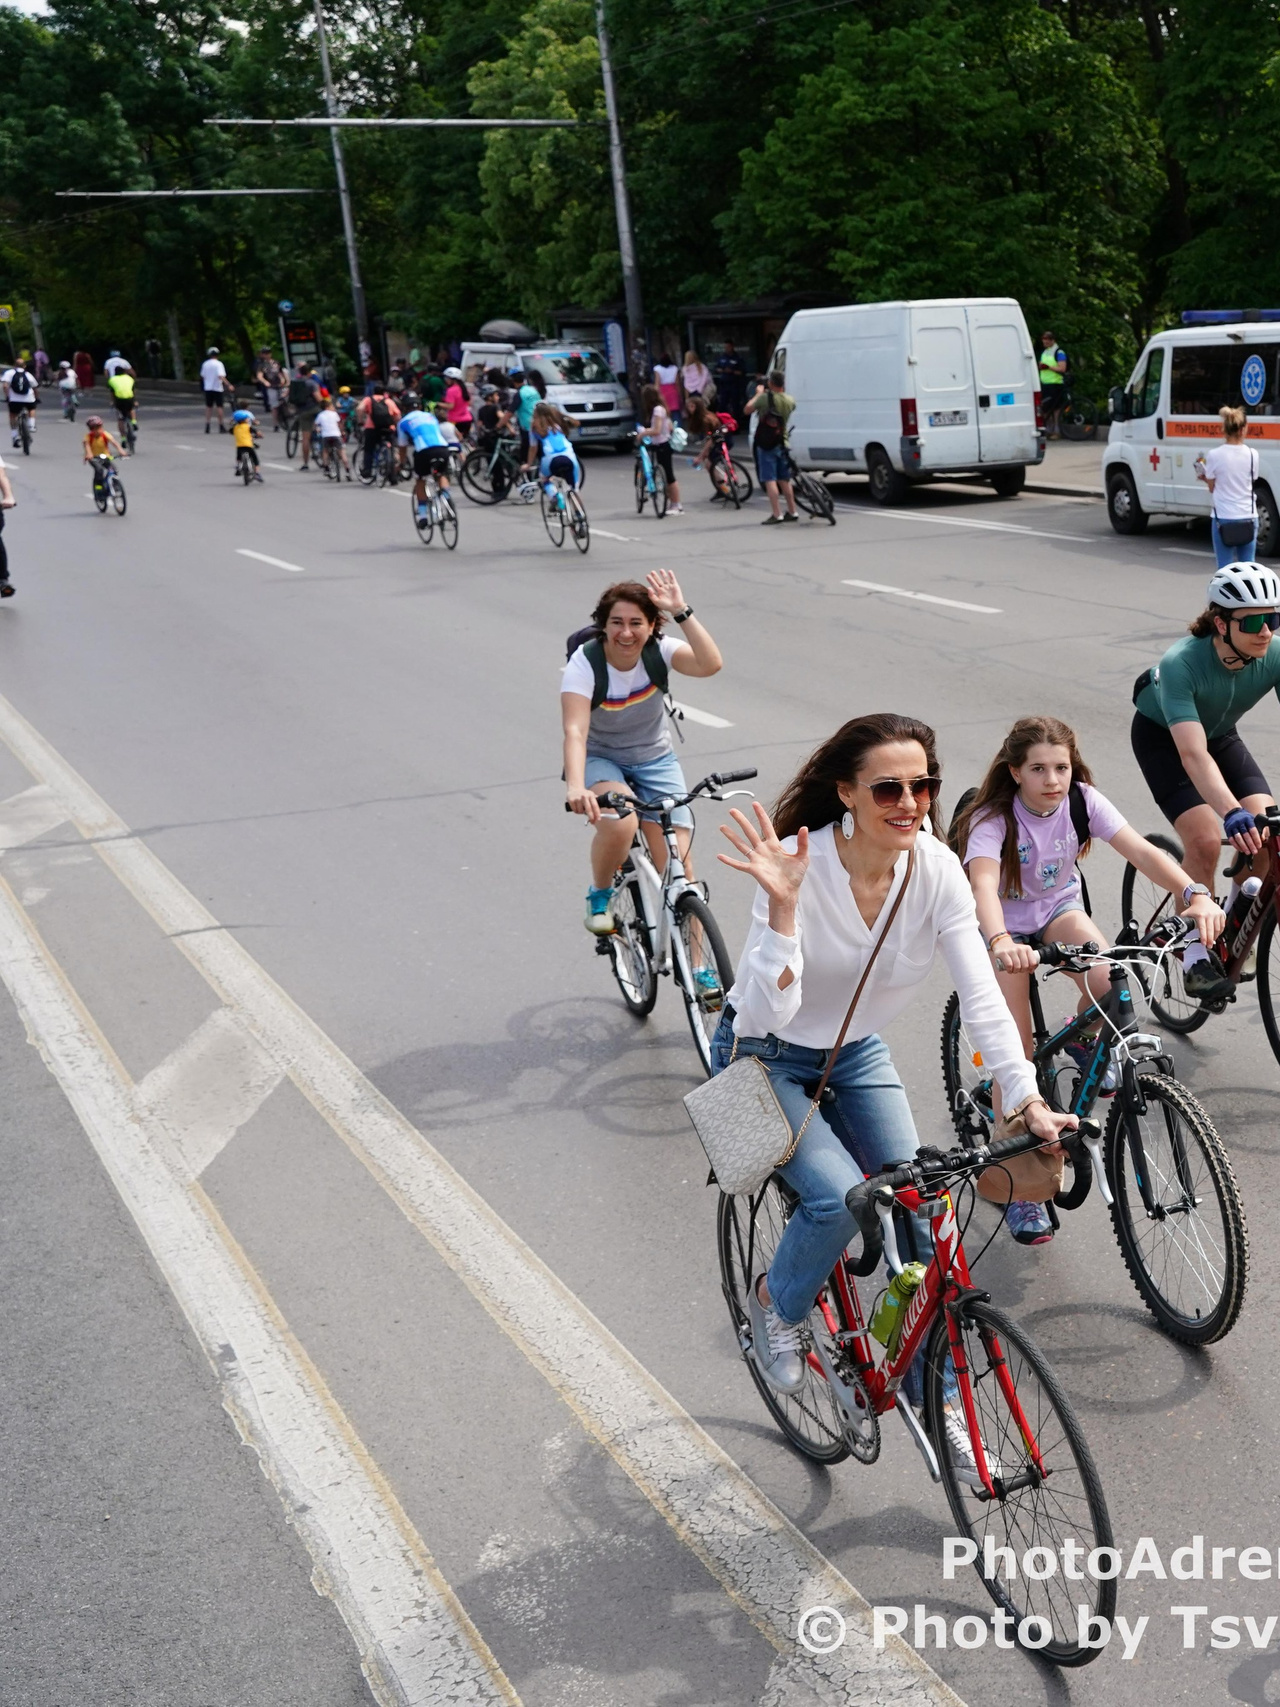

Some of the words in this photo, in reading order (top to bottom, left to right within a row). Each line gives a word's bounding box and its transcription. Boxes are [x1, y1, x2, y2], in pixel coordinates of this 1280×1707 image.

[1174, 423, 1197, 434] ПЪРВА
[1231, 893, 1264, 959] GIANT
[880, 1277, 929, 1386] SPEALIZED
